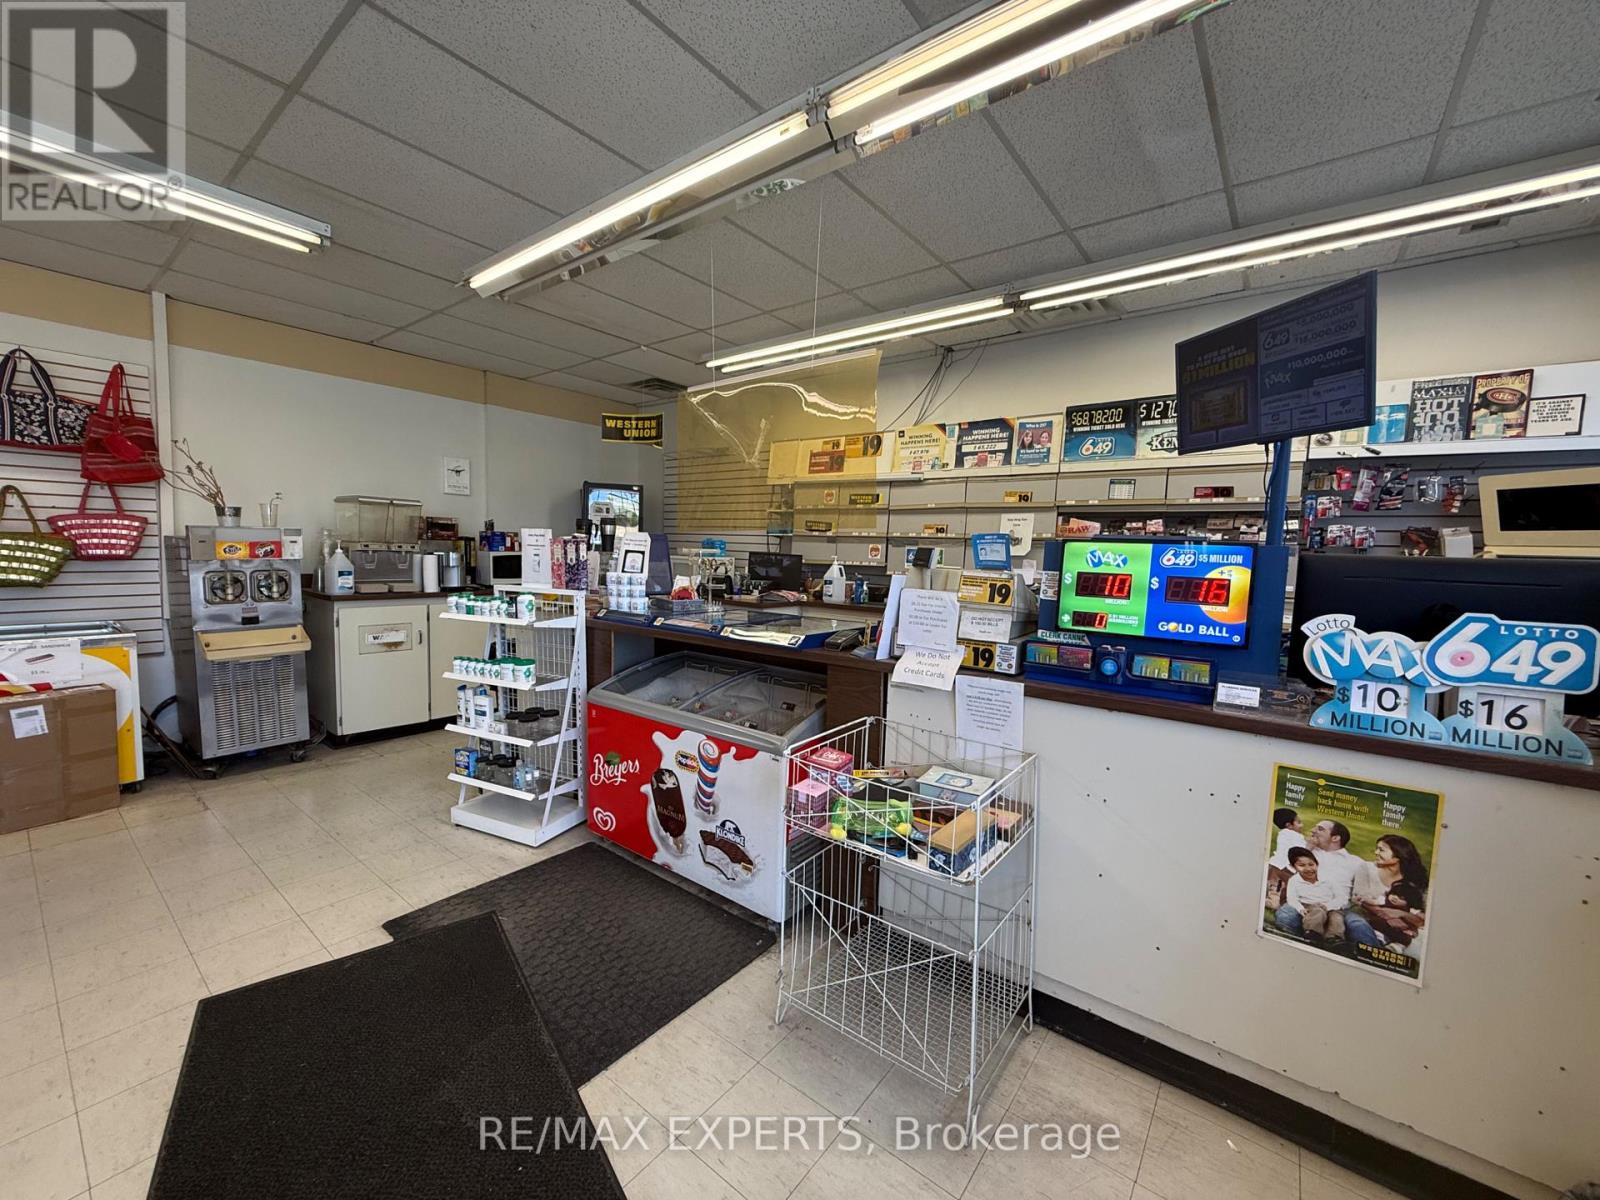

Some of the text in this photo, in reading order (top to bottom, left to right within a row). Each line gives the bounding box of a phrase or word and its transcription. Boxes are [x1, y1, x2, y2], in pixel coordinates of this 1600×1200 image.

[1519, 373, 1531, 384] OF
[1413, 386, 1467, 398] MAXIM
[1414, 398, 1465, 413] HOT
[605, 418, 656, 428] WESTERN
[1413, 410, 1461, 426] 100
[623, 428, 656, 437] UNION
[963, 432, 1009, 441] HAPPENS HERE!
[862, 435, 882, 456] 19
[1068, 525, 1090, 533] RAW
[1087, 549, 1127, 568] MAX
[1162, 549, 1243, 566] 649 $5 MILLION
[1064, 572, 1131, 597] $ 10
[1151, 576, 1229, 603] $ 16
[988, 582, 1011, 603] 19
[1199, 625, 1229, 636] BALL
[1307, 617, 1351, 636] Lotto
[1500, 626, 1579, 640] LOTTO
[1041, 631, 1061, 640] CLERK
[939, 652, 951, 660] Not
[972, 646, 994, 668] 19
[1311, 629, 1441, 687] MAX
[1434, 622, 1586, 686] 649
[904, 667, 945, 679] Credit Cards
[1330, 711, 1425, 739] MILLION
[1452, 726, 1563, 757] MILLION
[590, 753, 640, 786] Breyers
[1286, 782, 1306, 793] Happy
[1285, 790, 1305, 801] family
[1318, 788, 1358, 803] Send money
[1317, 797, 1369, 813] back home with
[1317, 805, 1345, 816] Western
[1384, 801, 1406, 813] Happy
[657, 804, 685, 823] MAGNUM
[1382, 809, 1405, 822] family
[715, 824, 745, 848] KLONDIKE
[1359, 943, 1405, 961] WESTERN
[1372, 953, 1406, 965] UNION
